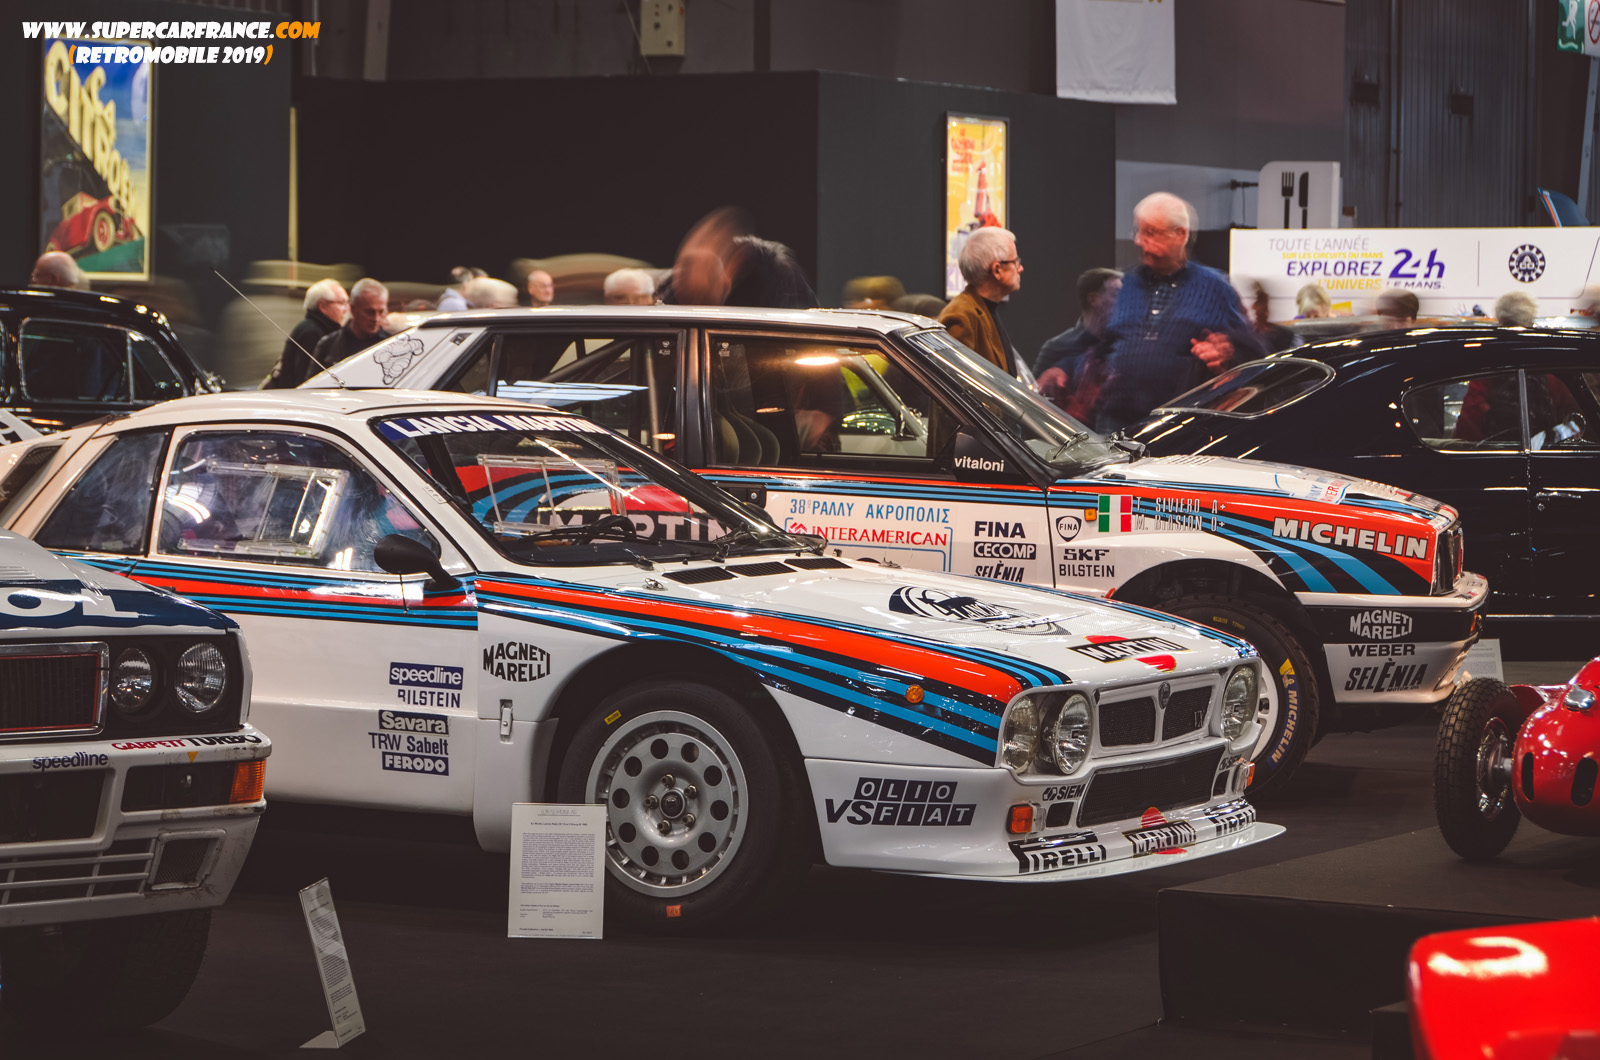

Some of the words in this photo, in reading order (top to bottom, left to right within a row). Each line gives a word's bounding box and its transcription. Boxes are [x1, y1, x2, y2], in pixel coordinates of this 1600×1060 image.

[1268, 237, 1311, 250] TOUTE
[1315, 234, 1369, 250] L'ANNÉE
[1287, 261, 1383, 276] EXPLOREZ
[1317, 278, 1382, 290] L'UNIVERS
[1404, 281, 1442, 290] MANS
[384, 415, 507, 438] LANCIA
[954, 456, 1005, 472] vitaloni
[865, 504, 950, 523] ΑΚΡΟΠΟΛΙΣ
[1155, 497, 1201, 513] SIVIERO
[1211, 499, 1226, 514] A+
[811, 525, 948, 546] INTERAMERICAN
[974, 521, 1026, 538] FINA
[1059, 523, 1078, 531] FINA
[1272, 516, 1429, 560] MICHELIN
[975, 543, 1035, 559] CECOMP
[1063, 548, 1110, 561] SKF
[1059, 564, 1115, 578] BILSTEIN
[1350, 610, 1412, 631] MAGNETI
[1350, 619, 1412, 639] MARELLI
[483, 641, 551, 670] MAGNETI
[1077, 638, 1182, 661] MARTINI
[1348, 643, 1416, 657] WEBER
[390, 666, 462, 686] speedline
[483, 653, 551, 682] MARELLI
[1344, 658, 1428, 693] SELÈNIA
[397, 689, 461, 708] BILSTEIN
[381, 711, 447, 734] Savara
[1271, 689, 1298, 764] MICHELIN
[186, 734, 263, 747] TURBO
[368, 732, 402, 751] TRW
[406, 735, 449, 755] Sabelt
[32, 752, 109, 772] speedline
[384, 754, 446, 773] FERODO
[859, 780, 952, 800] OLIO
[1056, 783, 1086, 800] SIEM
[825, 799, 875, 825] VS
[878, 805, 971, 823] FIAT
[1128, 823, 1195, 854] MARTINI
